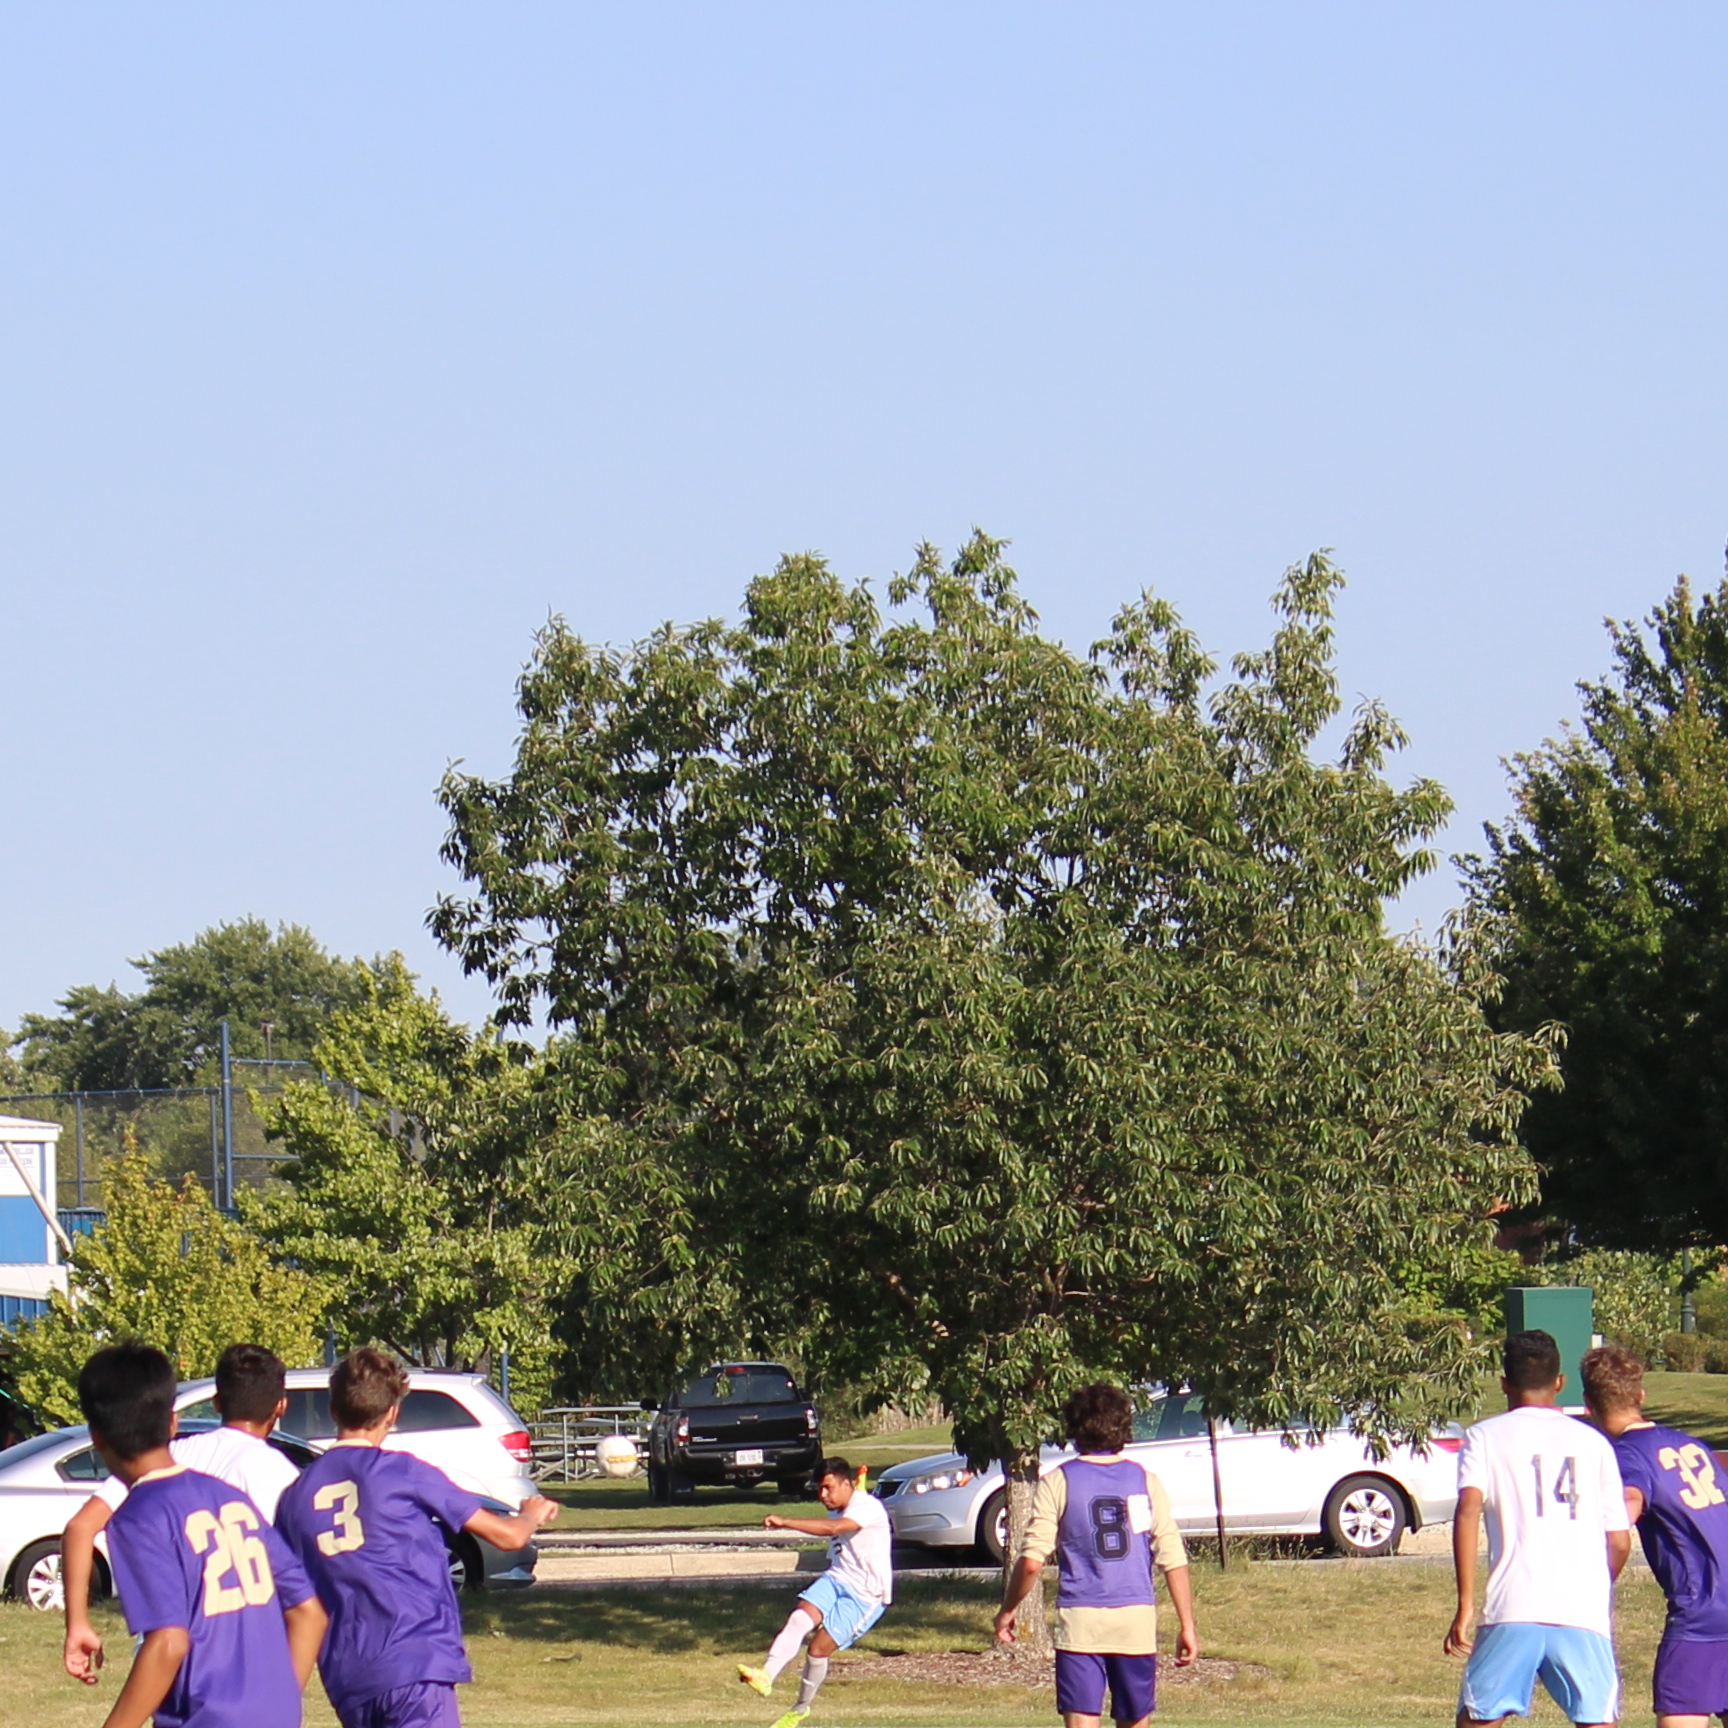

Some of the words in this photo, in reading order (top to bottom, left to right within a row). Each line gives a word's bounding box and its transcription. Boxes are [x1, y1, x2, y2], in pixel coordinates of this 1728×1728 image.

[1530, 1453, 1581, 1520] 14
[1658, 1443, 1726, 1510] 32
[313, 1480, 365, 1557] 3
[1087, 1494, 1131, 1563] 8
[184, 1500, 275, 1617] 26
